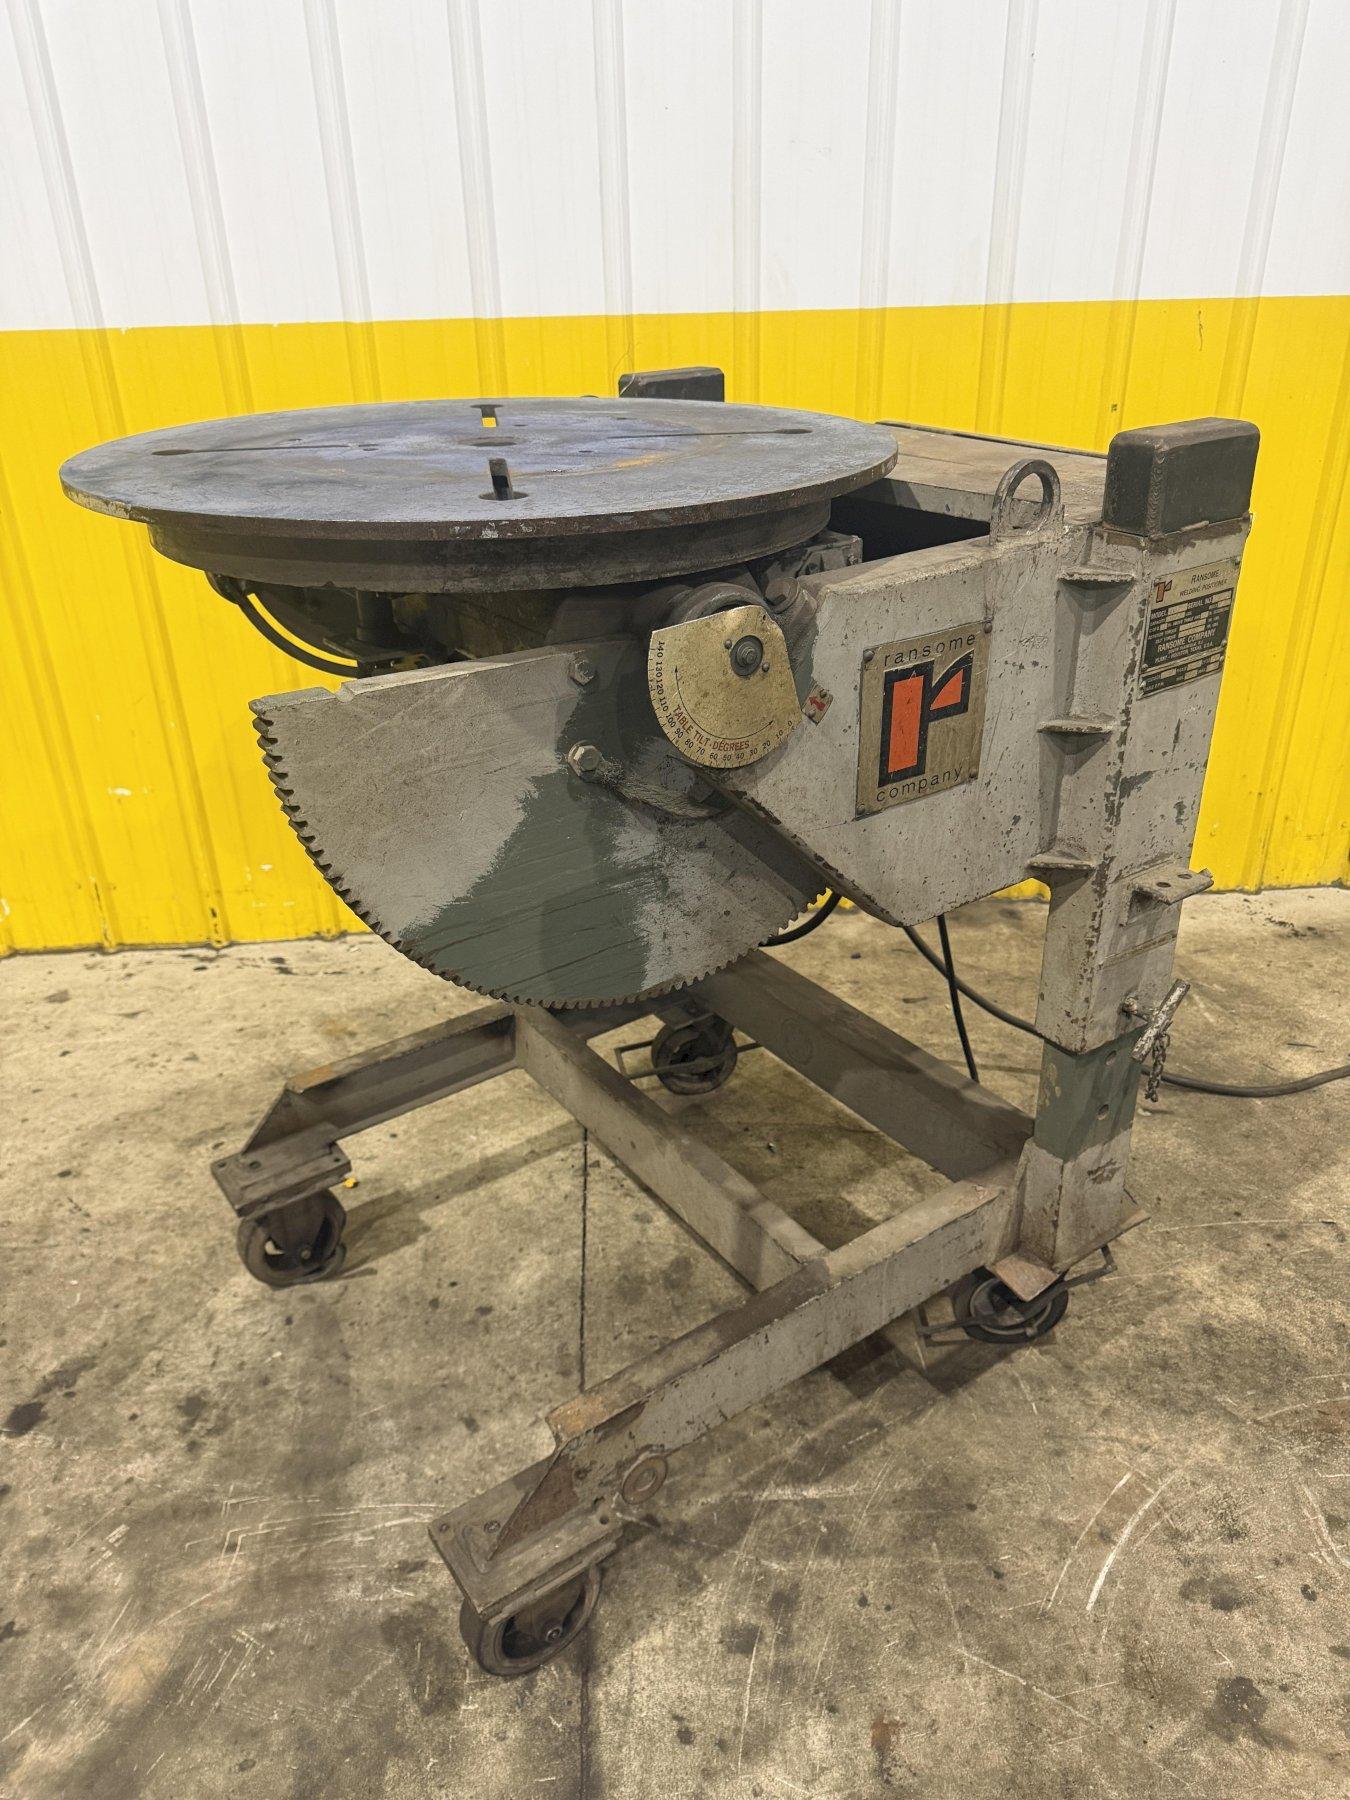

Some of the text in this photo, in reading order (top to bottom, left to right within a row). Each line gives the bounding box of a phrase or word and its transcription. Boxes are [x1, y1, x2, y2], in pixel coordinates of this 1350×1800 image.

[1191, 570, 1220, 584] RANSOME
[1187, 600, 1204, 610] SERIAL
[1157, 636, 1186, 652] RANSOME
[1187, 628, 1217, 644] COMPANY
[657, 641, 665, 658] 140
[884, 634, 977, 667] ransome
[656, 679, 664, 695] 120
[660, 697, 668, 712] 110
[666, 714, 676, 728] 100
[673, 704, 694, 734] TABLE
[674, 728, 683, 738] 90
[776, 730, 783, 739] 10
[685, 739, 694, 748] 80
[762, 740, 770, 750] 20
[696, 746, 705, 756] 70
[709, 752, 718, 760] 60
[876, 765, 963, 802] company
